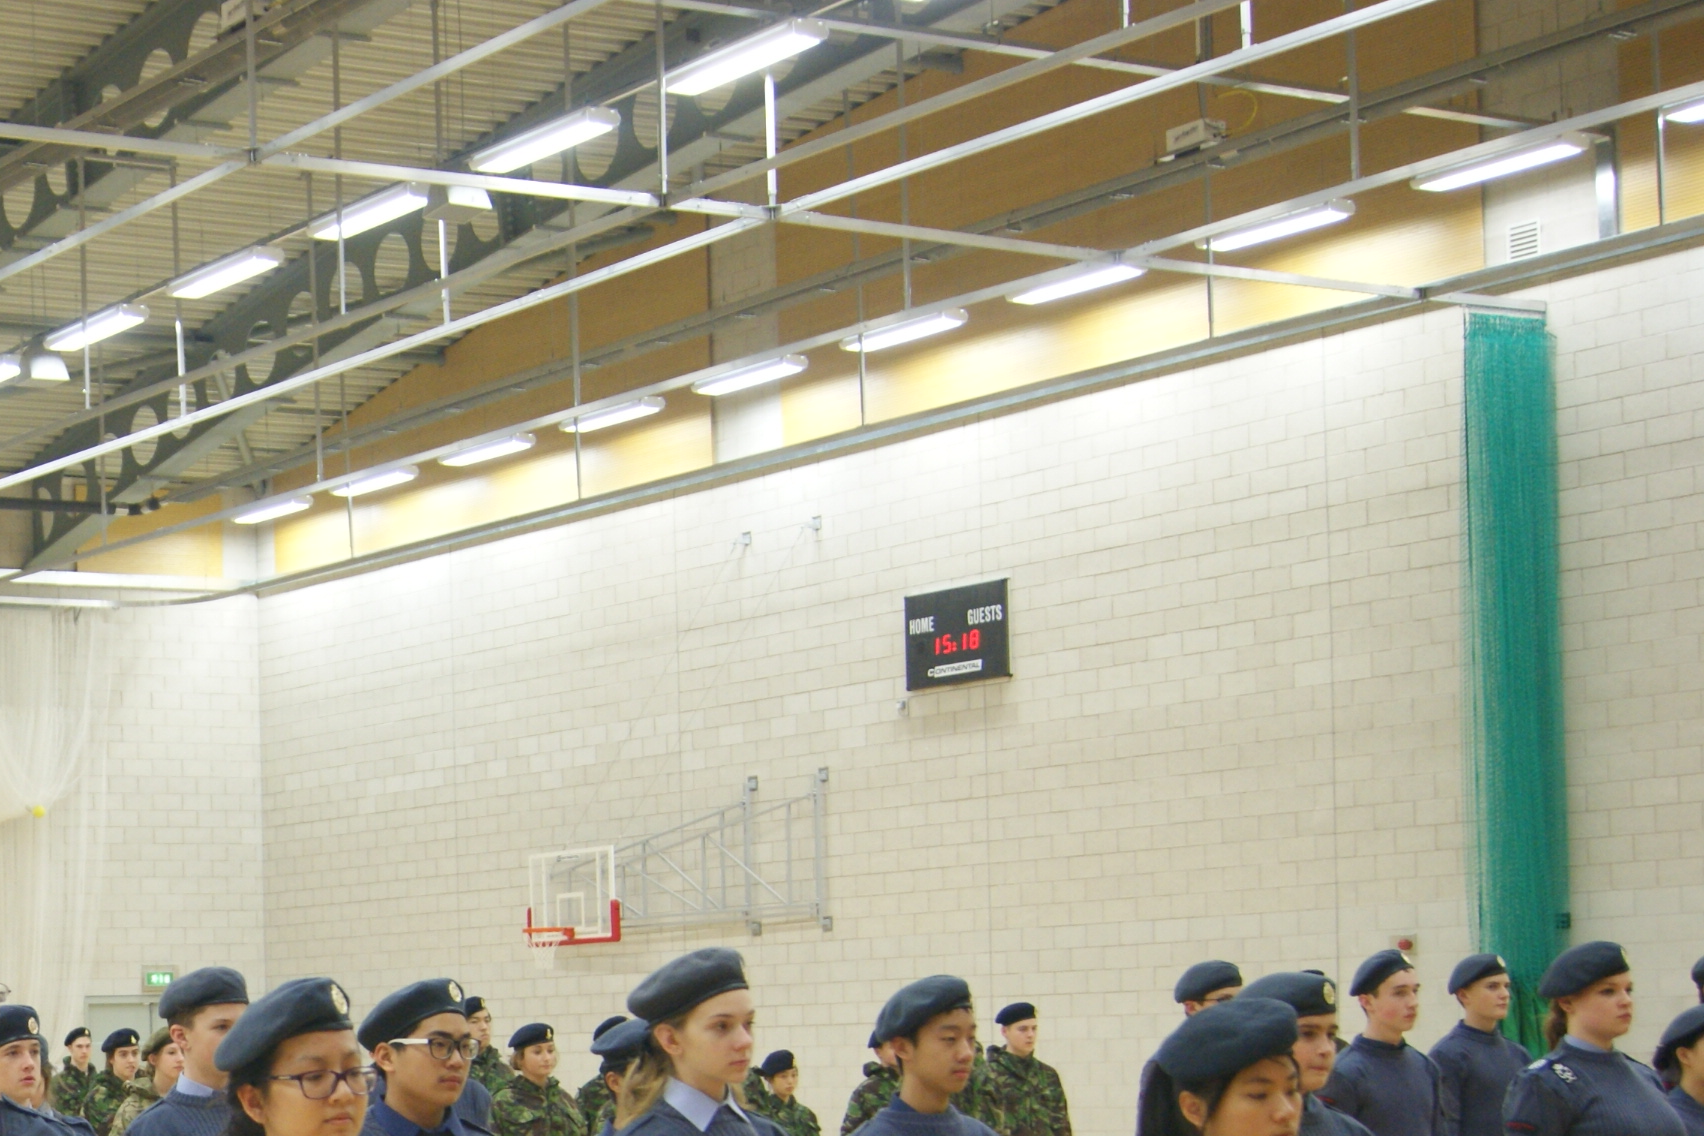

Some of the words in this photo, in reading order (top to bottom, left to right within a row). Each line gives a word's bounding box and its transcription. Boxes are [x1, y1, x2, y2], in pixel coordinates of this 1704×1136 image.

[909, 616, 935, 635] HOME
[967, 604, 1003, 625] GUESTS
[927, 660, 981, 678] CONTINENTAL
